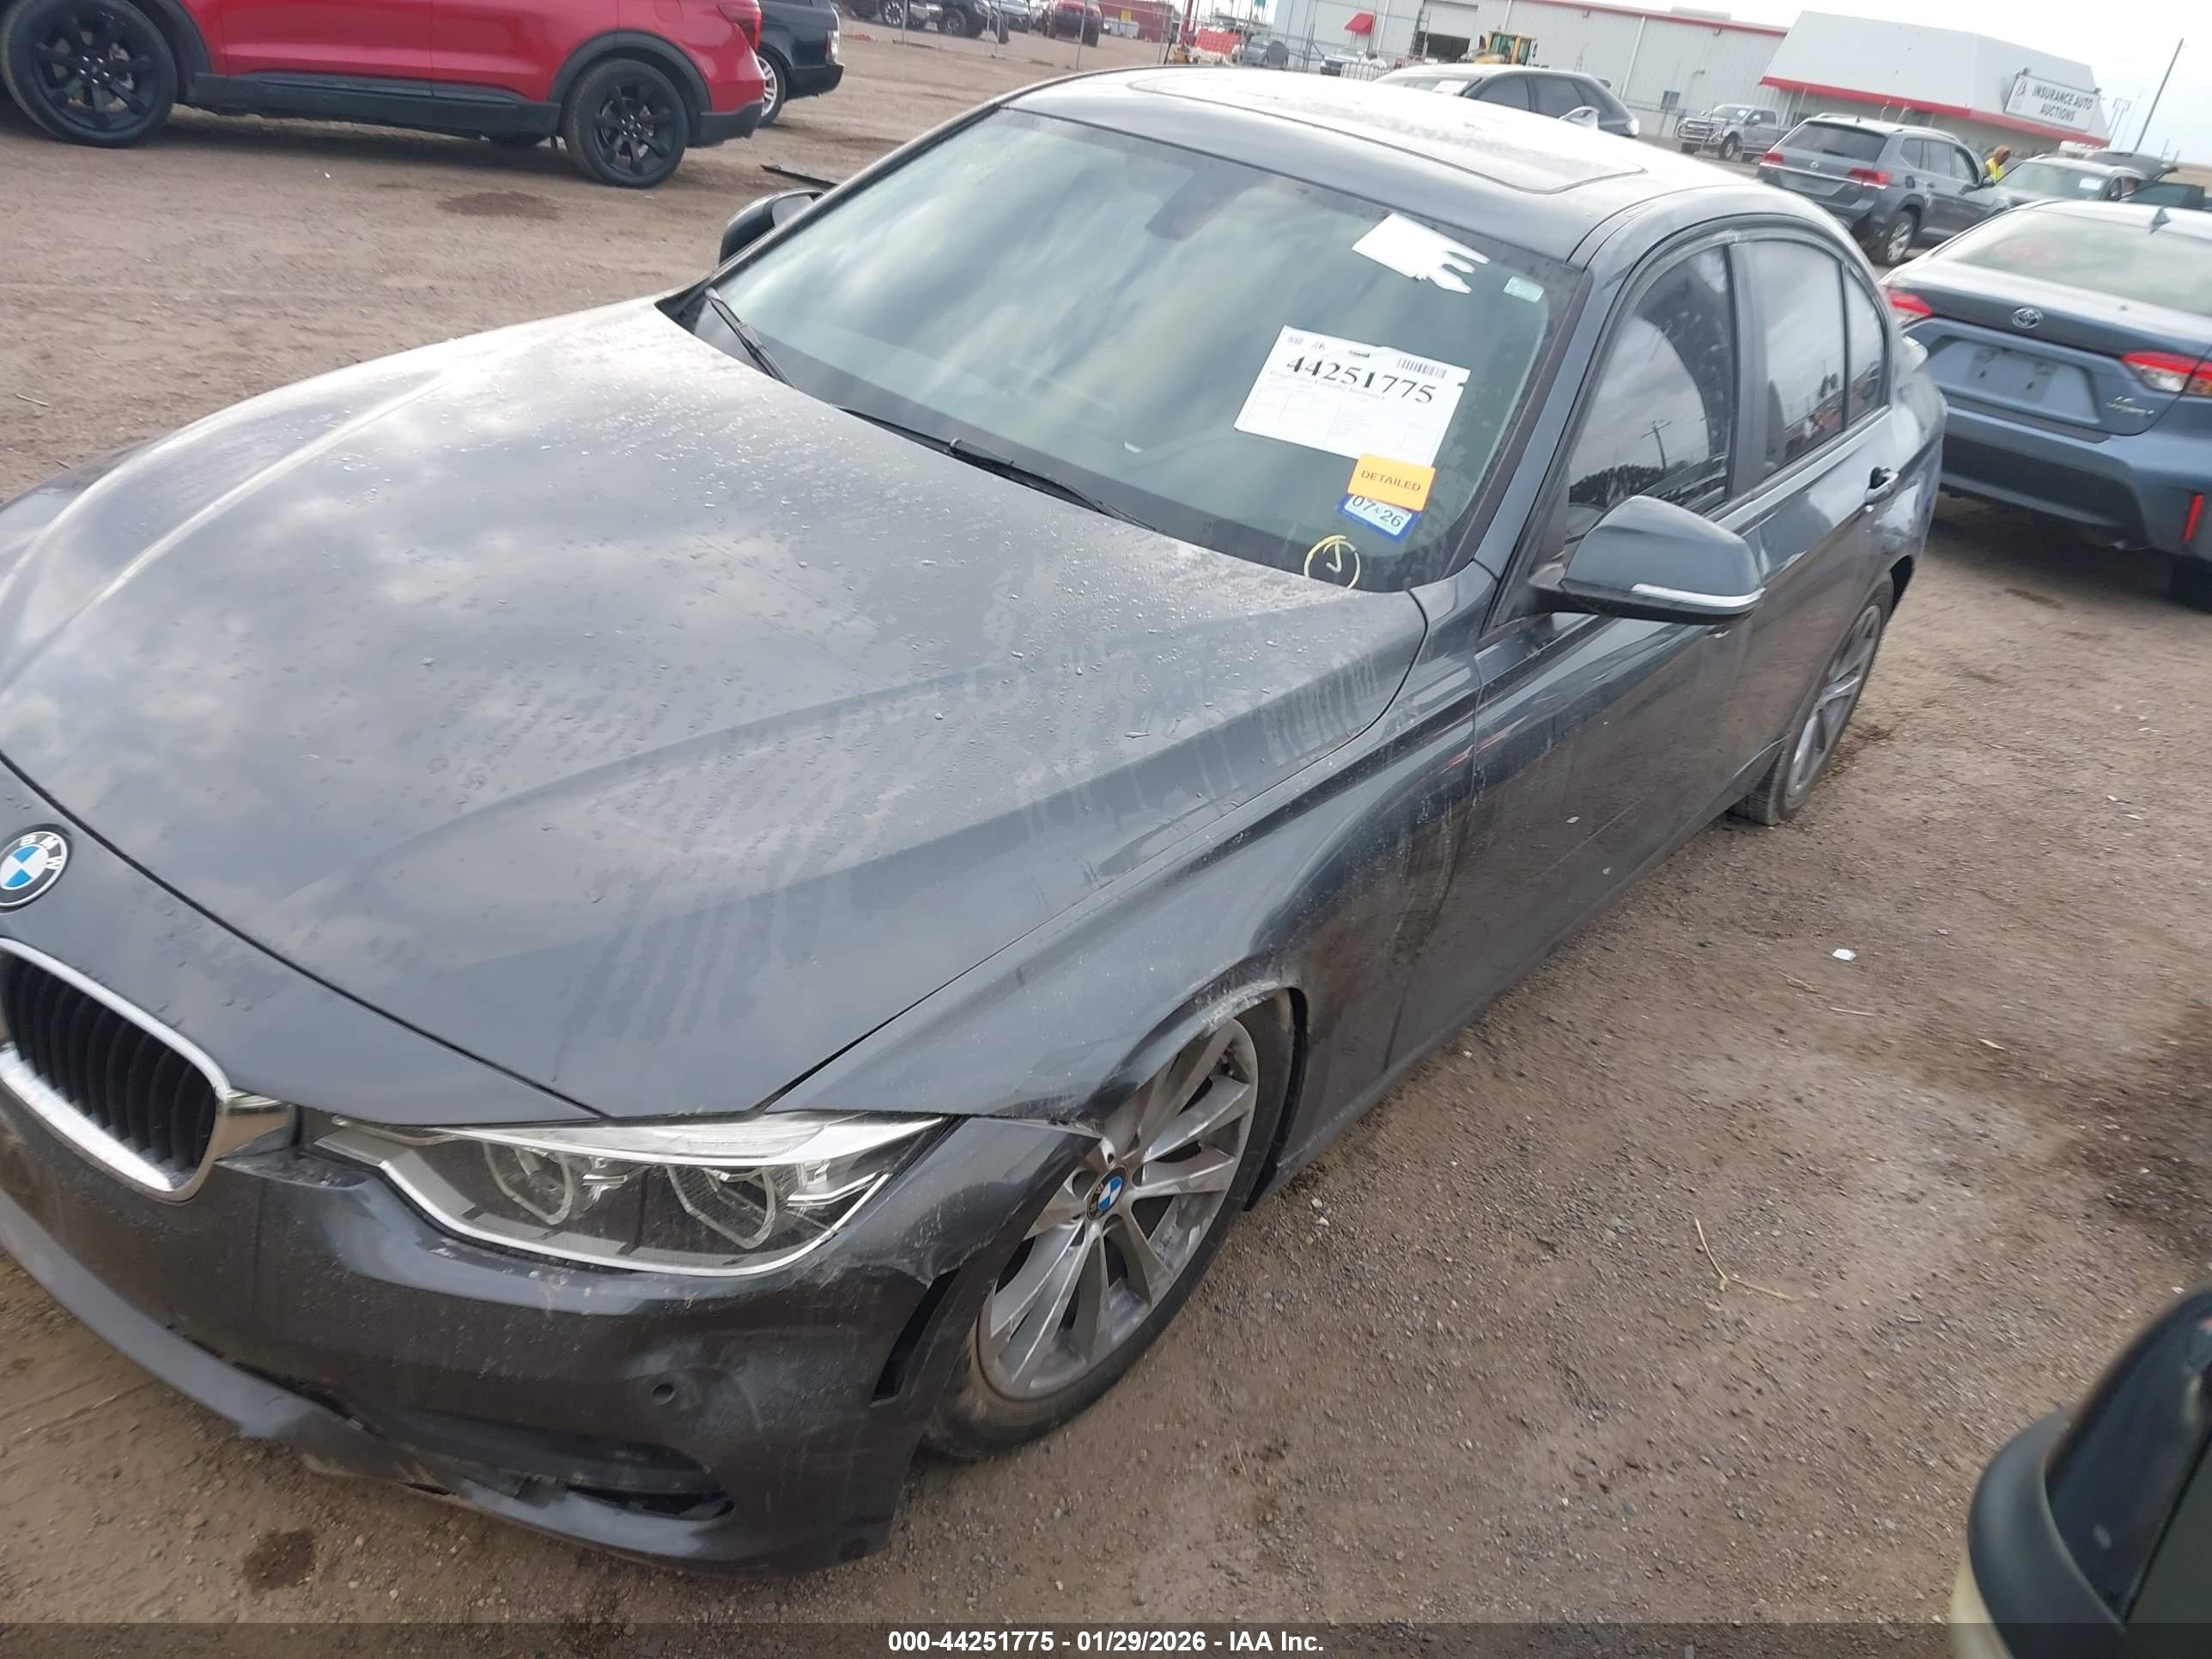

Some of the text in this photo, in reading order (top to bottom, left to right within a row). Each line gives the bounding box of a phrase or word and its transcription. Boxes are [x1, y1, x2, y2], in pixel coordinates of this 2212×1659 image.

[2033, 84, 2074, 105] INSURANCE
[2074, 95, 2093, 110] AUTO
[2039, 102, 2075, 122] AUCTIONS
[1285, 356, 1437, 404] 44251775
[1361, 470, 1421, 491] DETAILED
[1352, 495, 1404, 527] 07 26
[19, 833, 63, 870] BMW
